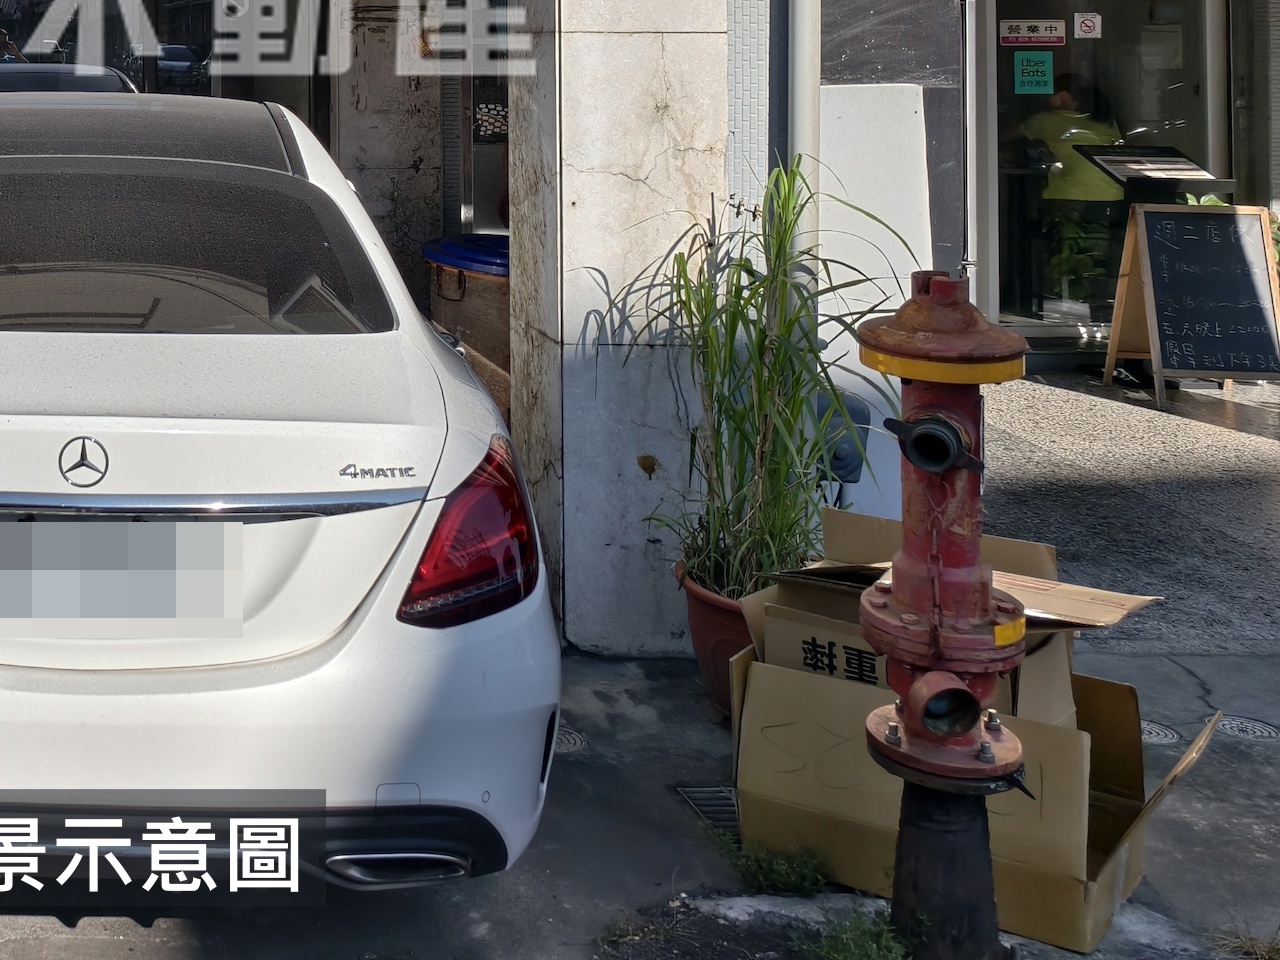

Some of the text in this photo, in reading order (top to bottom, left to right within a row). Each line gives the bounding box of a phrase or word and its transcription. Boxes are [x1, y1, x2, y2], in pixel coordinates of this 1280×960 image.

[1007, 24, 1058, 35] 營業中
[1021, 57, 1047, 68] Uber
[1021, 68, 1047, 78] Eats
[339, 463, 416, 479] 4MATIC
